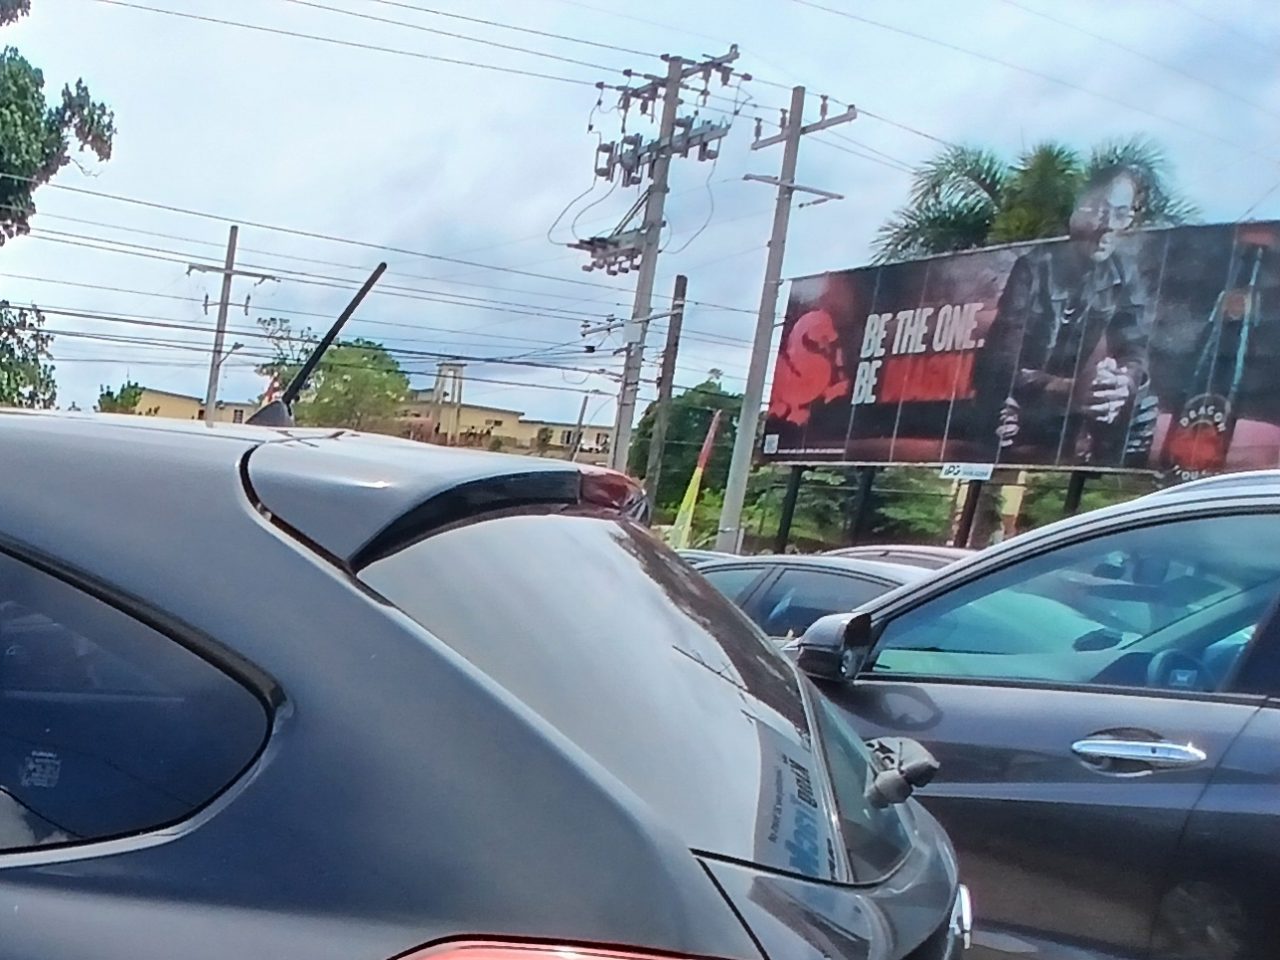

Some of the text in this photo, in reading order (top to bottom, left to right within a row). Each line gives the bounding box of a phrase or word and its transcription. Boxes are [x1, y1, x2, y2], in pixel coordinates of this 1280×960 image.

[860, 302, 985, 358] BE THE ONE.
[851, 360, 882, 404] BE
[1180, 405, 1226, 432] DRAGON
